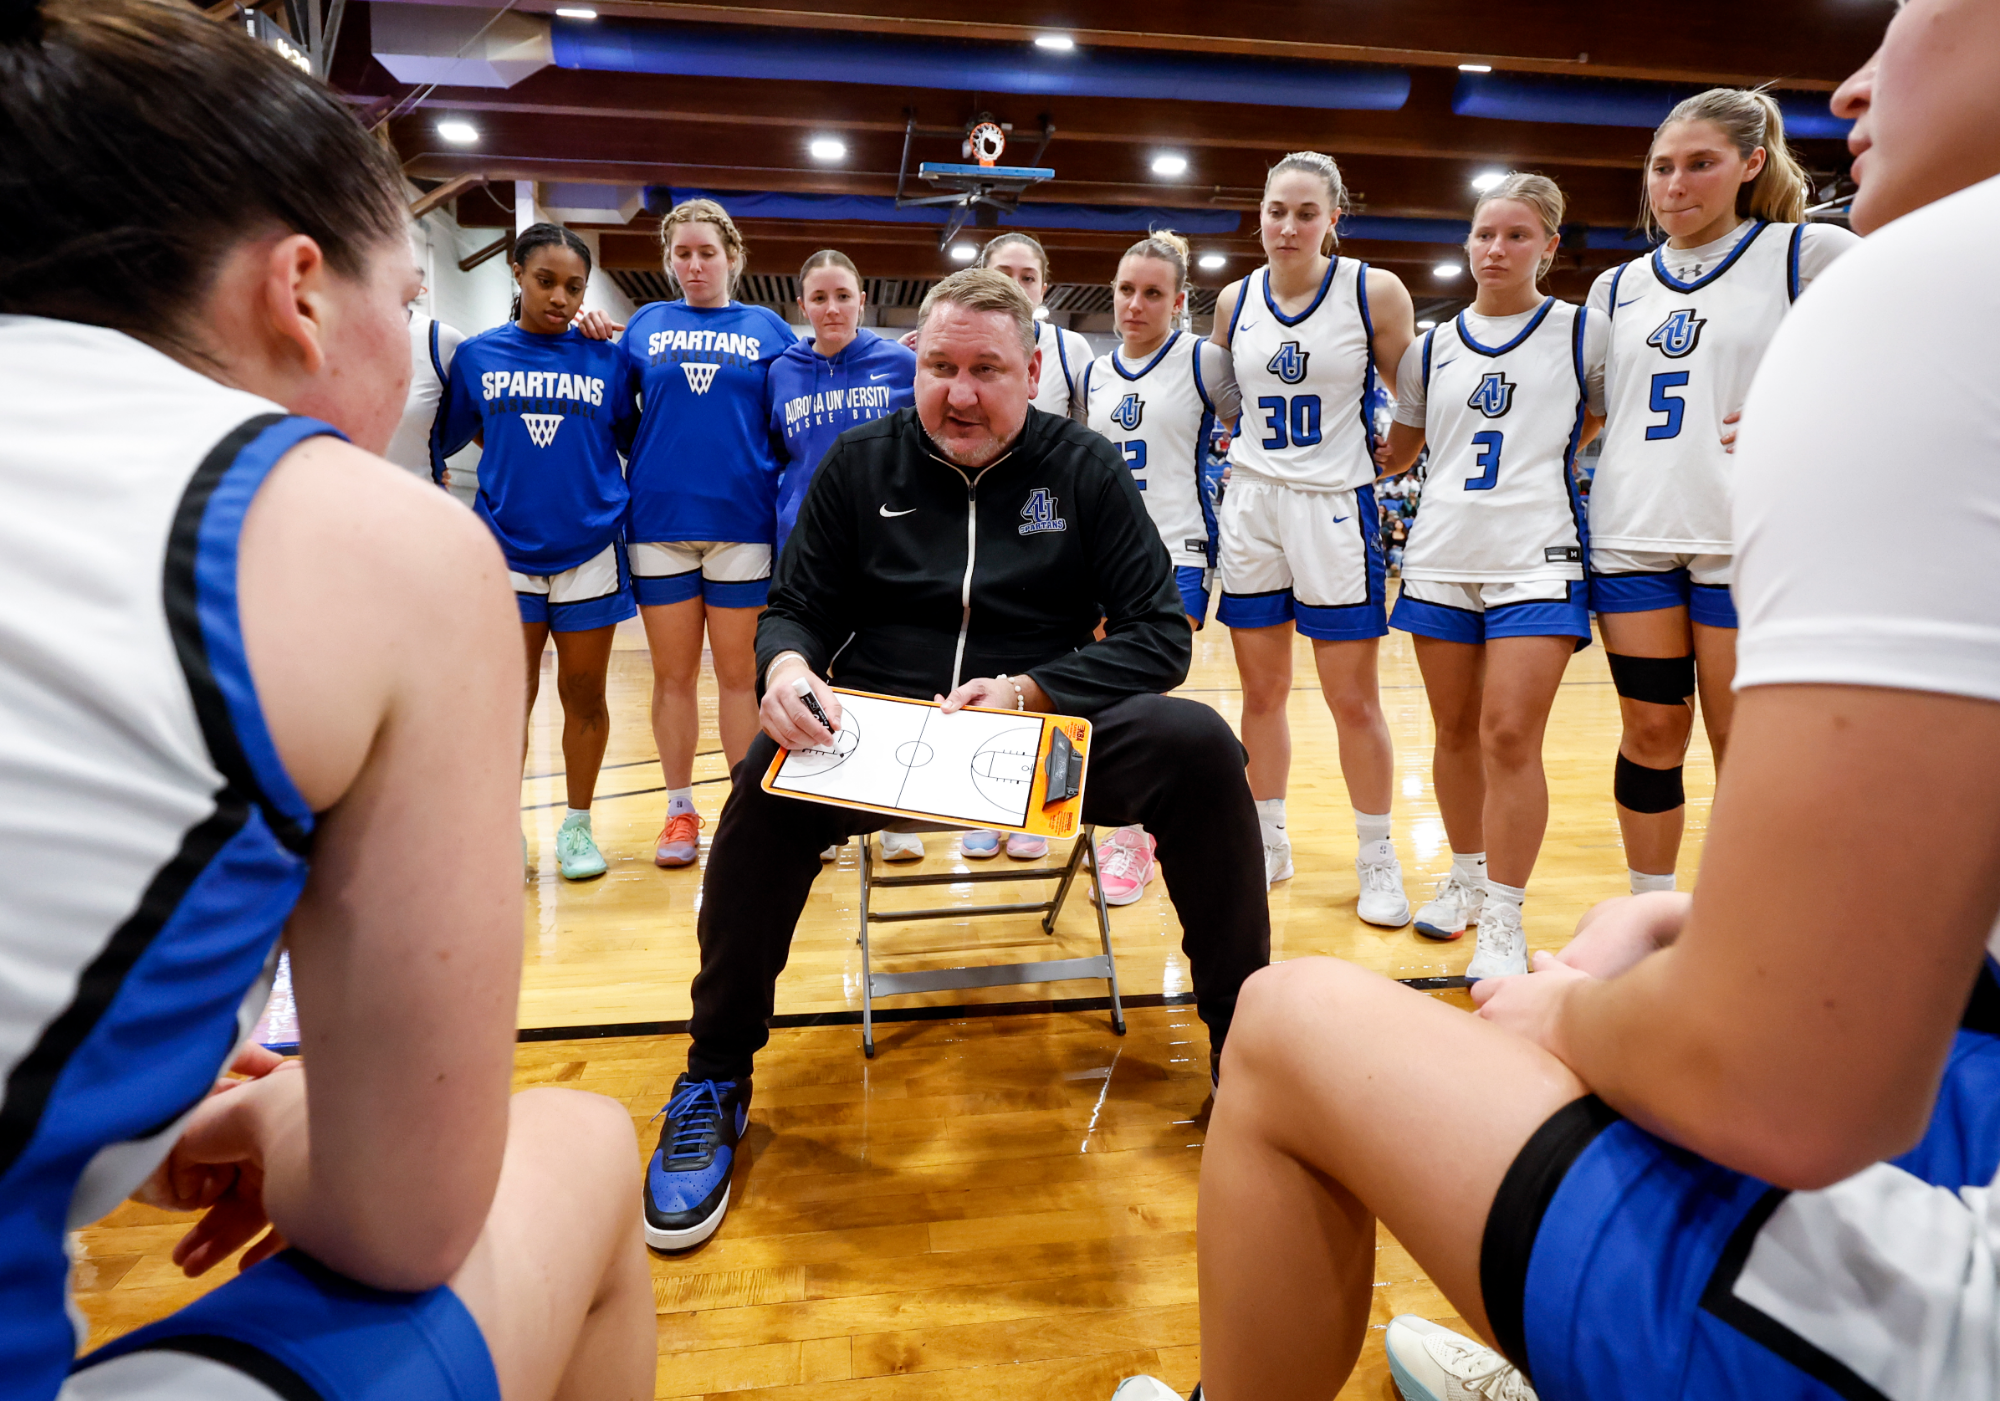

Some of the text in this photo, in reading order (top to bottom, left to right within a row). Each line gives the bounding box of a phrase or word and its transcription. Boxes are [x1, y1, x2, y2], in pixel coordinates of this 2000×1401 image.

[648, 330, 761, 361] SPARTANS
[1646, 308, 1707, 359] AU
[652, 351, 753, 372] BASKETBALL
[1266, 341, 1310, 385] AU
[481, 371, 605, 407] SPARTANS
[1467, 371, 1517, 419] AU
[1645, 370, 1690, 441] 5
[488, 399, 596, 420] BASKETBALL
[787, 409, 890, 438] BASKEBAL
[1110, 392, 1146, 431] AU
[1258, 394, 1322, 450] 30
[1464, 430, 1504, 491] 3
[1019, 519, 1065, 534] SPARTANS
